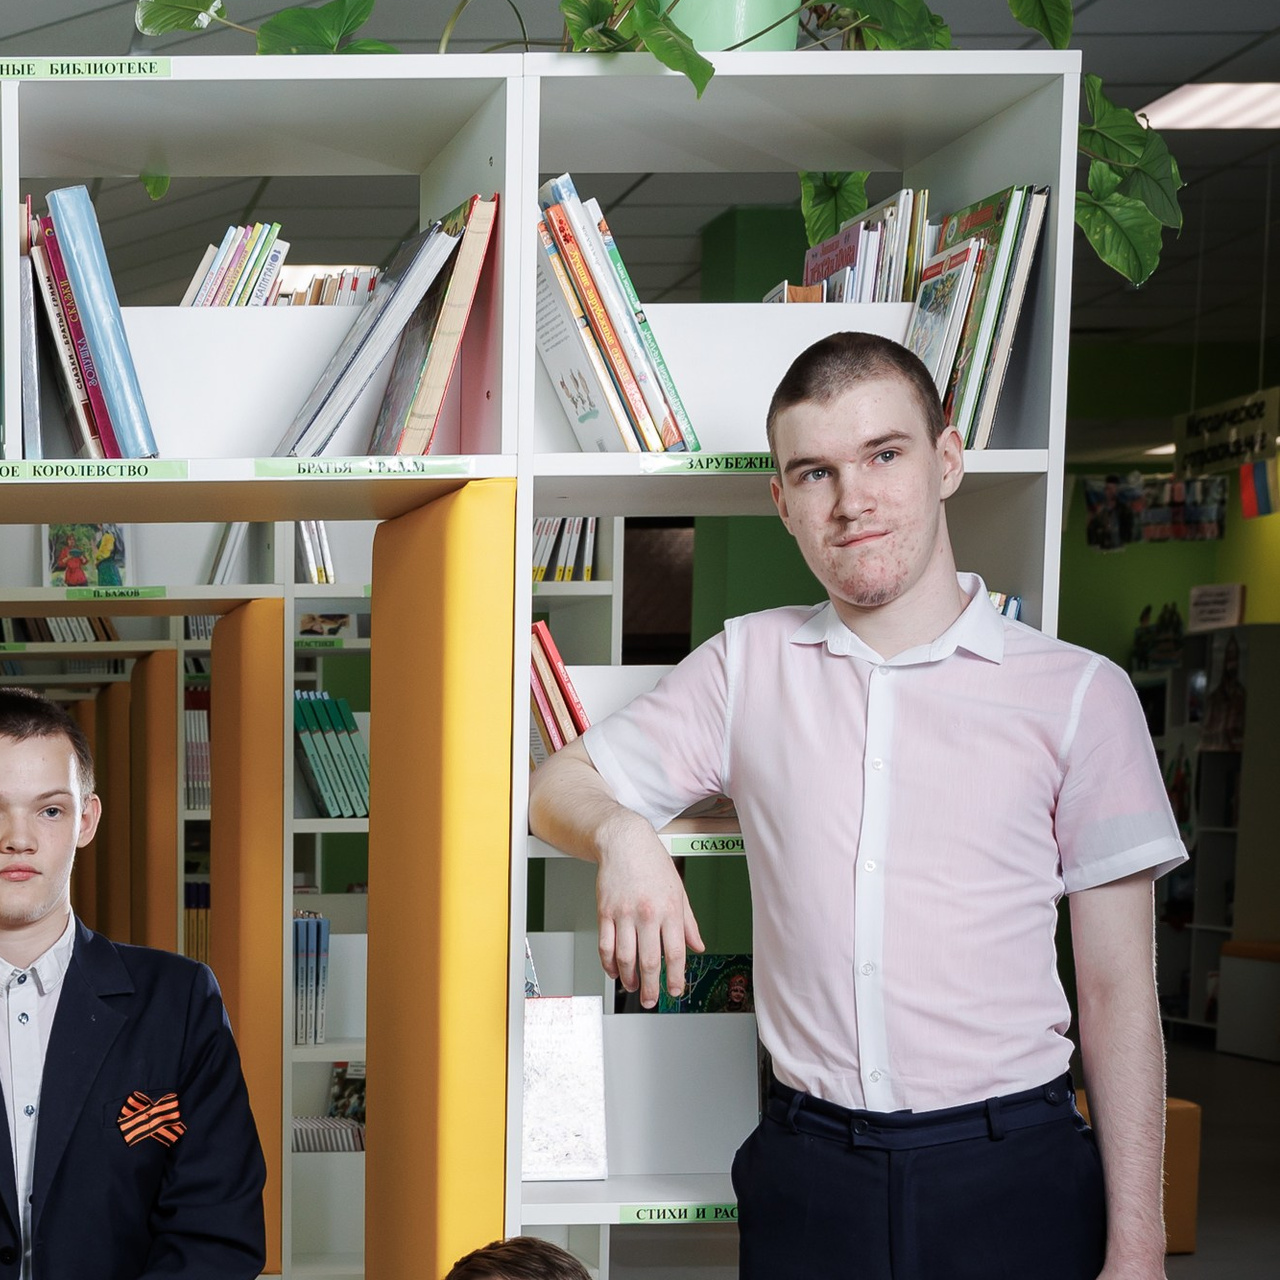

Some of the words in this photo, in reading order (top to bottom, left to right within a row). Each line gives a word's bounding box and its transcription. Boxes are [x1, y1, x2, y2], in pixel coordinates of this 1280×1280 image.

[49, 61, 158, 75] БИБЛИОТЕКЕ
[46, 276, 60, 307] ГРИММ
[60, 280, 78, 322] СКАЗКИ
[569, 249, 590, 287] Лучшие
[587, 287, 615, 346] зарубежные
[611, 346, 631, 385] сказки
[58, 312, 70, 345] БРАТЬЯ
[68, 354, 83, 390] СКАЗКИ
[78, 337, 98, 387] ЗОЛУШКА
[32, 464, 149, 478] КОРОЛЕВСТВО
[297, 462, 353, 474] БРАТЬЯ
[93, 590, 102, 598] П.
[105, 590, 140, 598] БАЖОВ
[690, 839, 744, 850] СКАЗОЧ
[636, 1209, 688, 1220] СТИХИ
[696, 1208, 706, 1218] И
